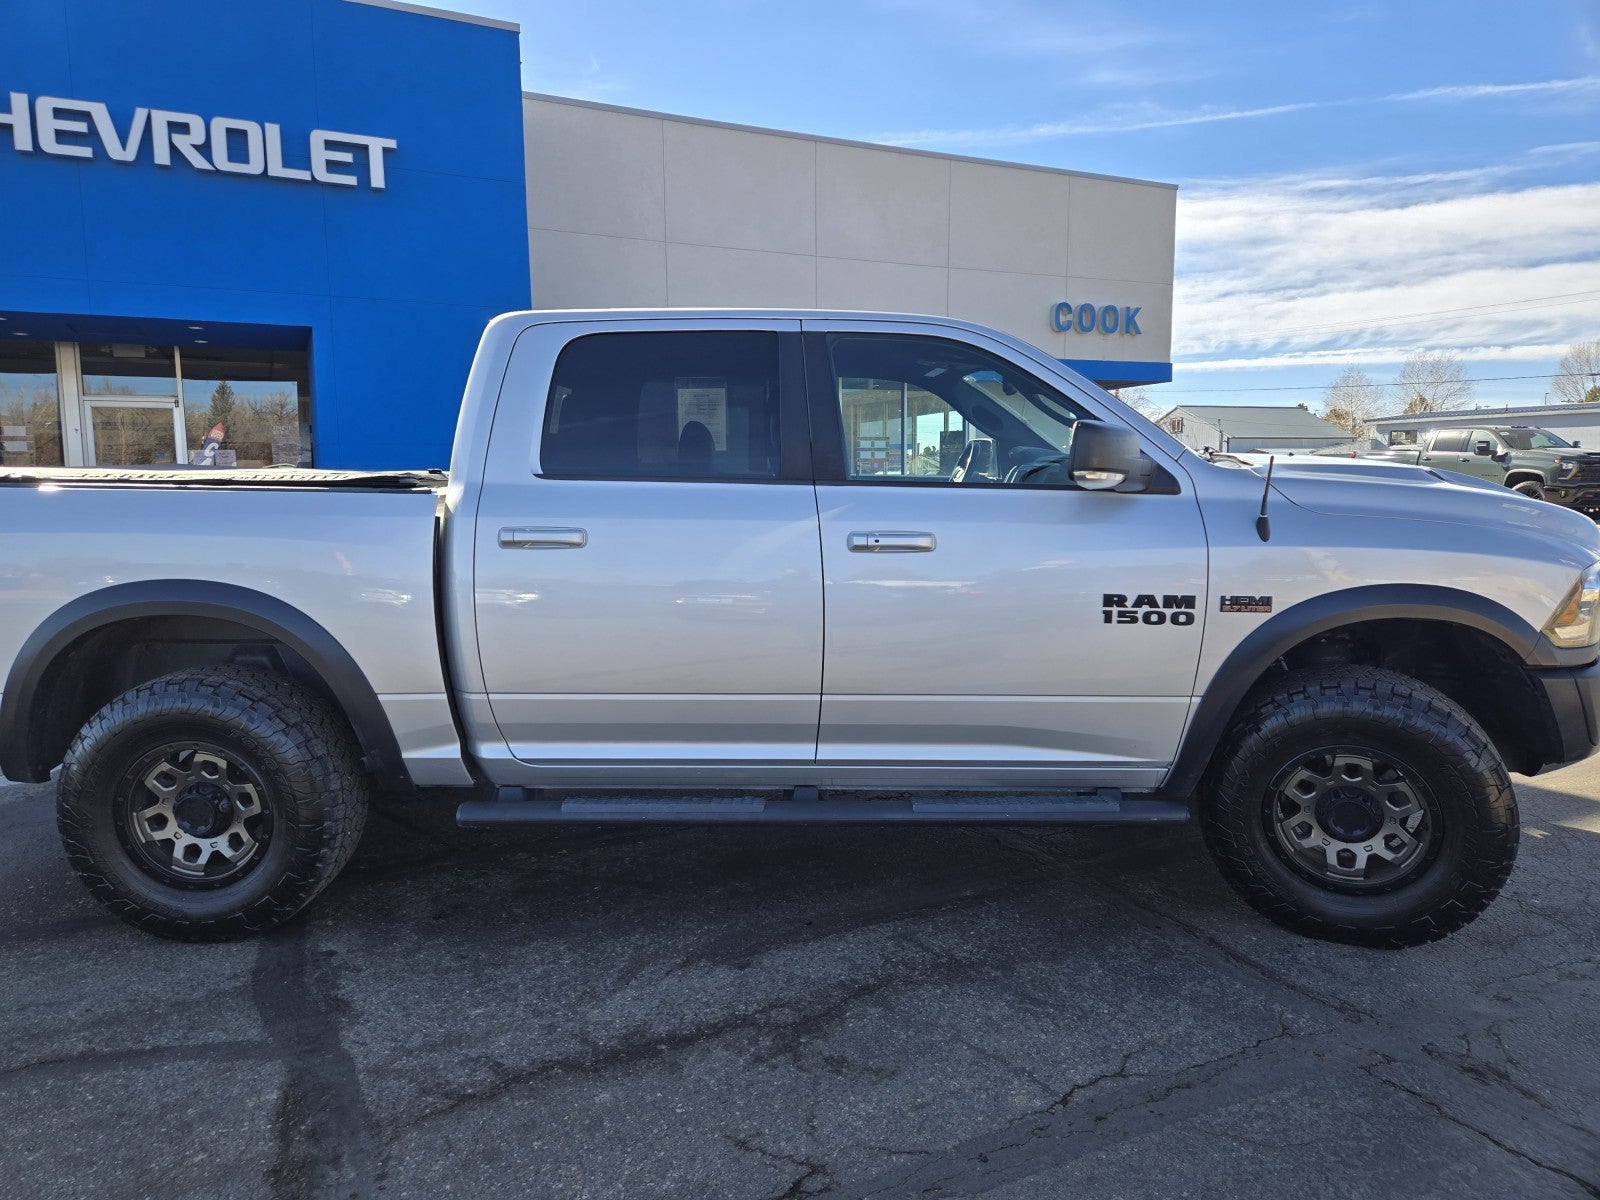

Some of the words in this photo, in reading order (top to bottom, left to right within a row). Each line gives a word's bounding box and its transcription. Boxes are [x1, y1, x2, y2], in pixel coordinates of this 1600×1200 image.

[1050, 302, 1142, 335] COOK
[1102, 593, 1196, 609] RAM
[1220, 595, 1273, 606] HEMI
[1102, 609, 1195, 626] 1500
